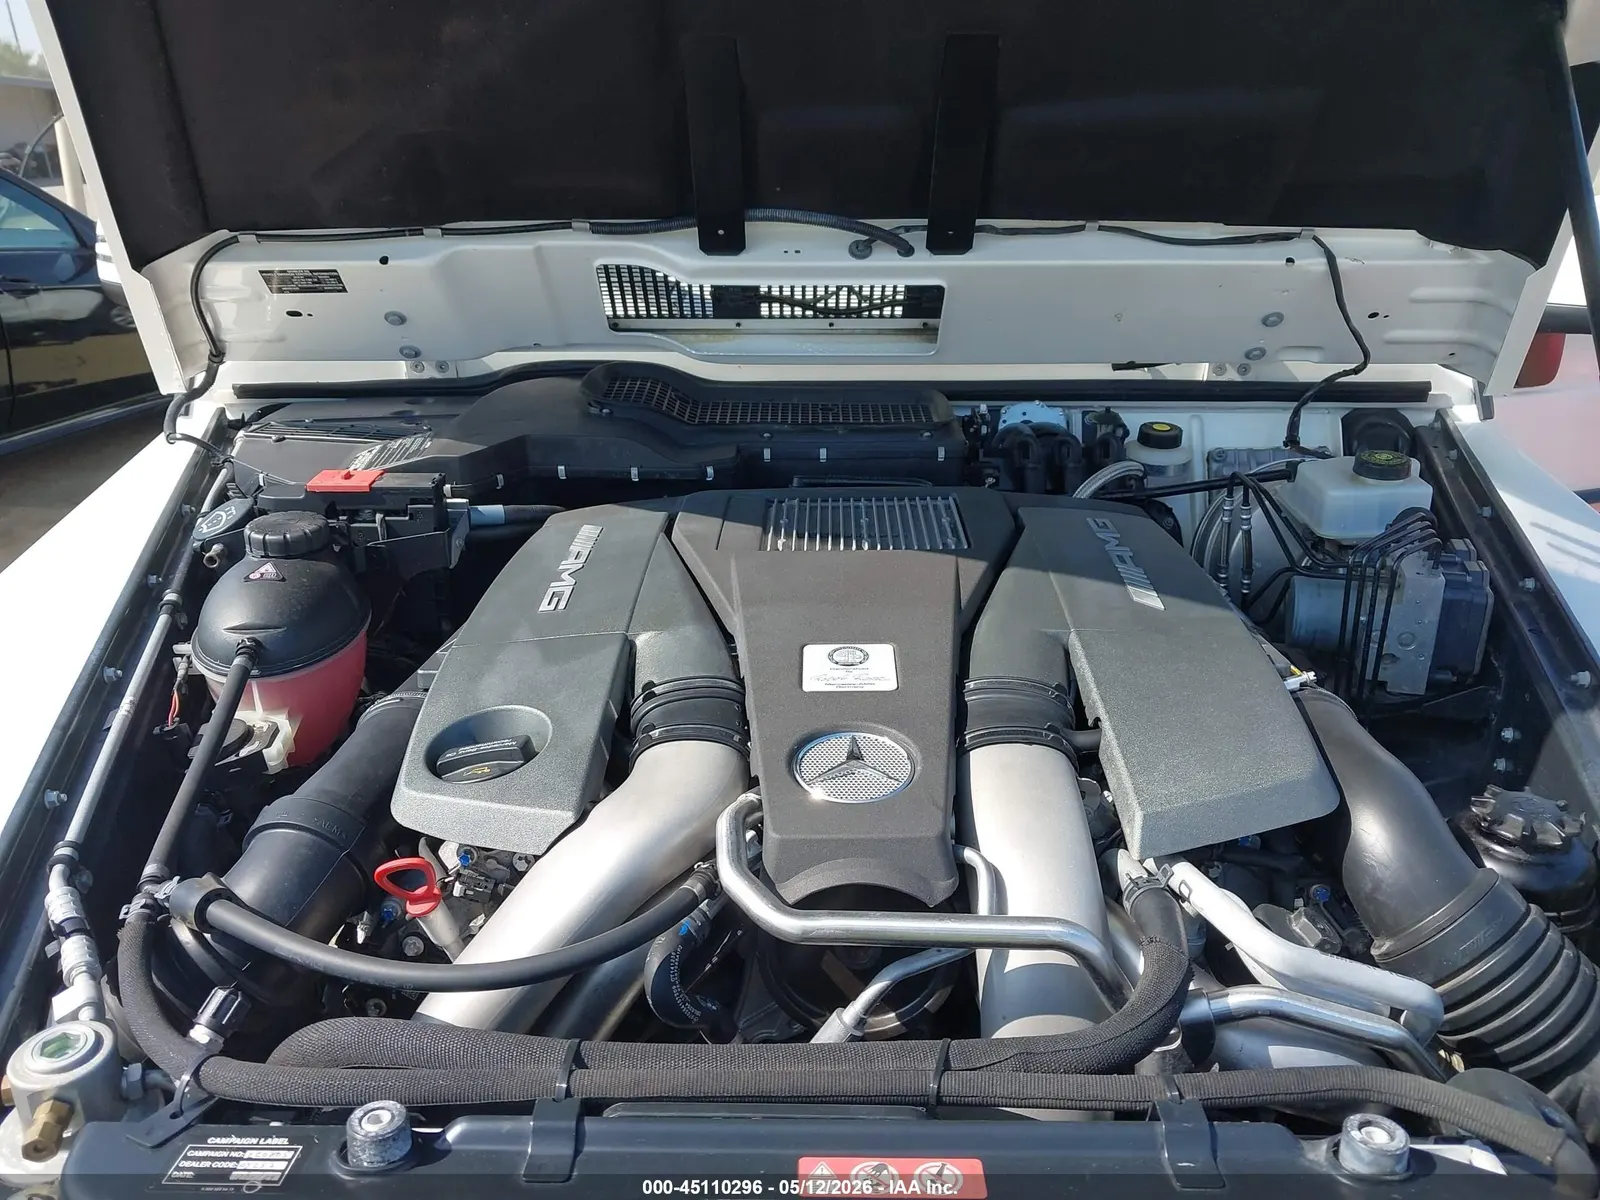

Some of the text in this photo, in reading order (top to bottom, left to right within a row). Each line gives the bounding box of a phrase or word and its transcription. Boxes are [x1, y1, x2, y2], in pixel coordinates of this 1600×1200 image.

[207, 1136, 290, 1145] CAMPAIGN LABEL
[178, 1160, 211, 1168] DEALER
